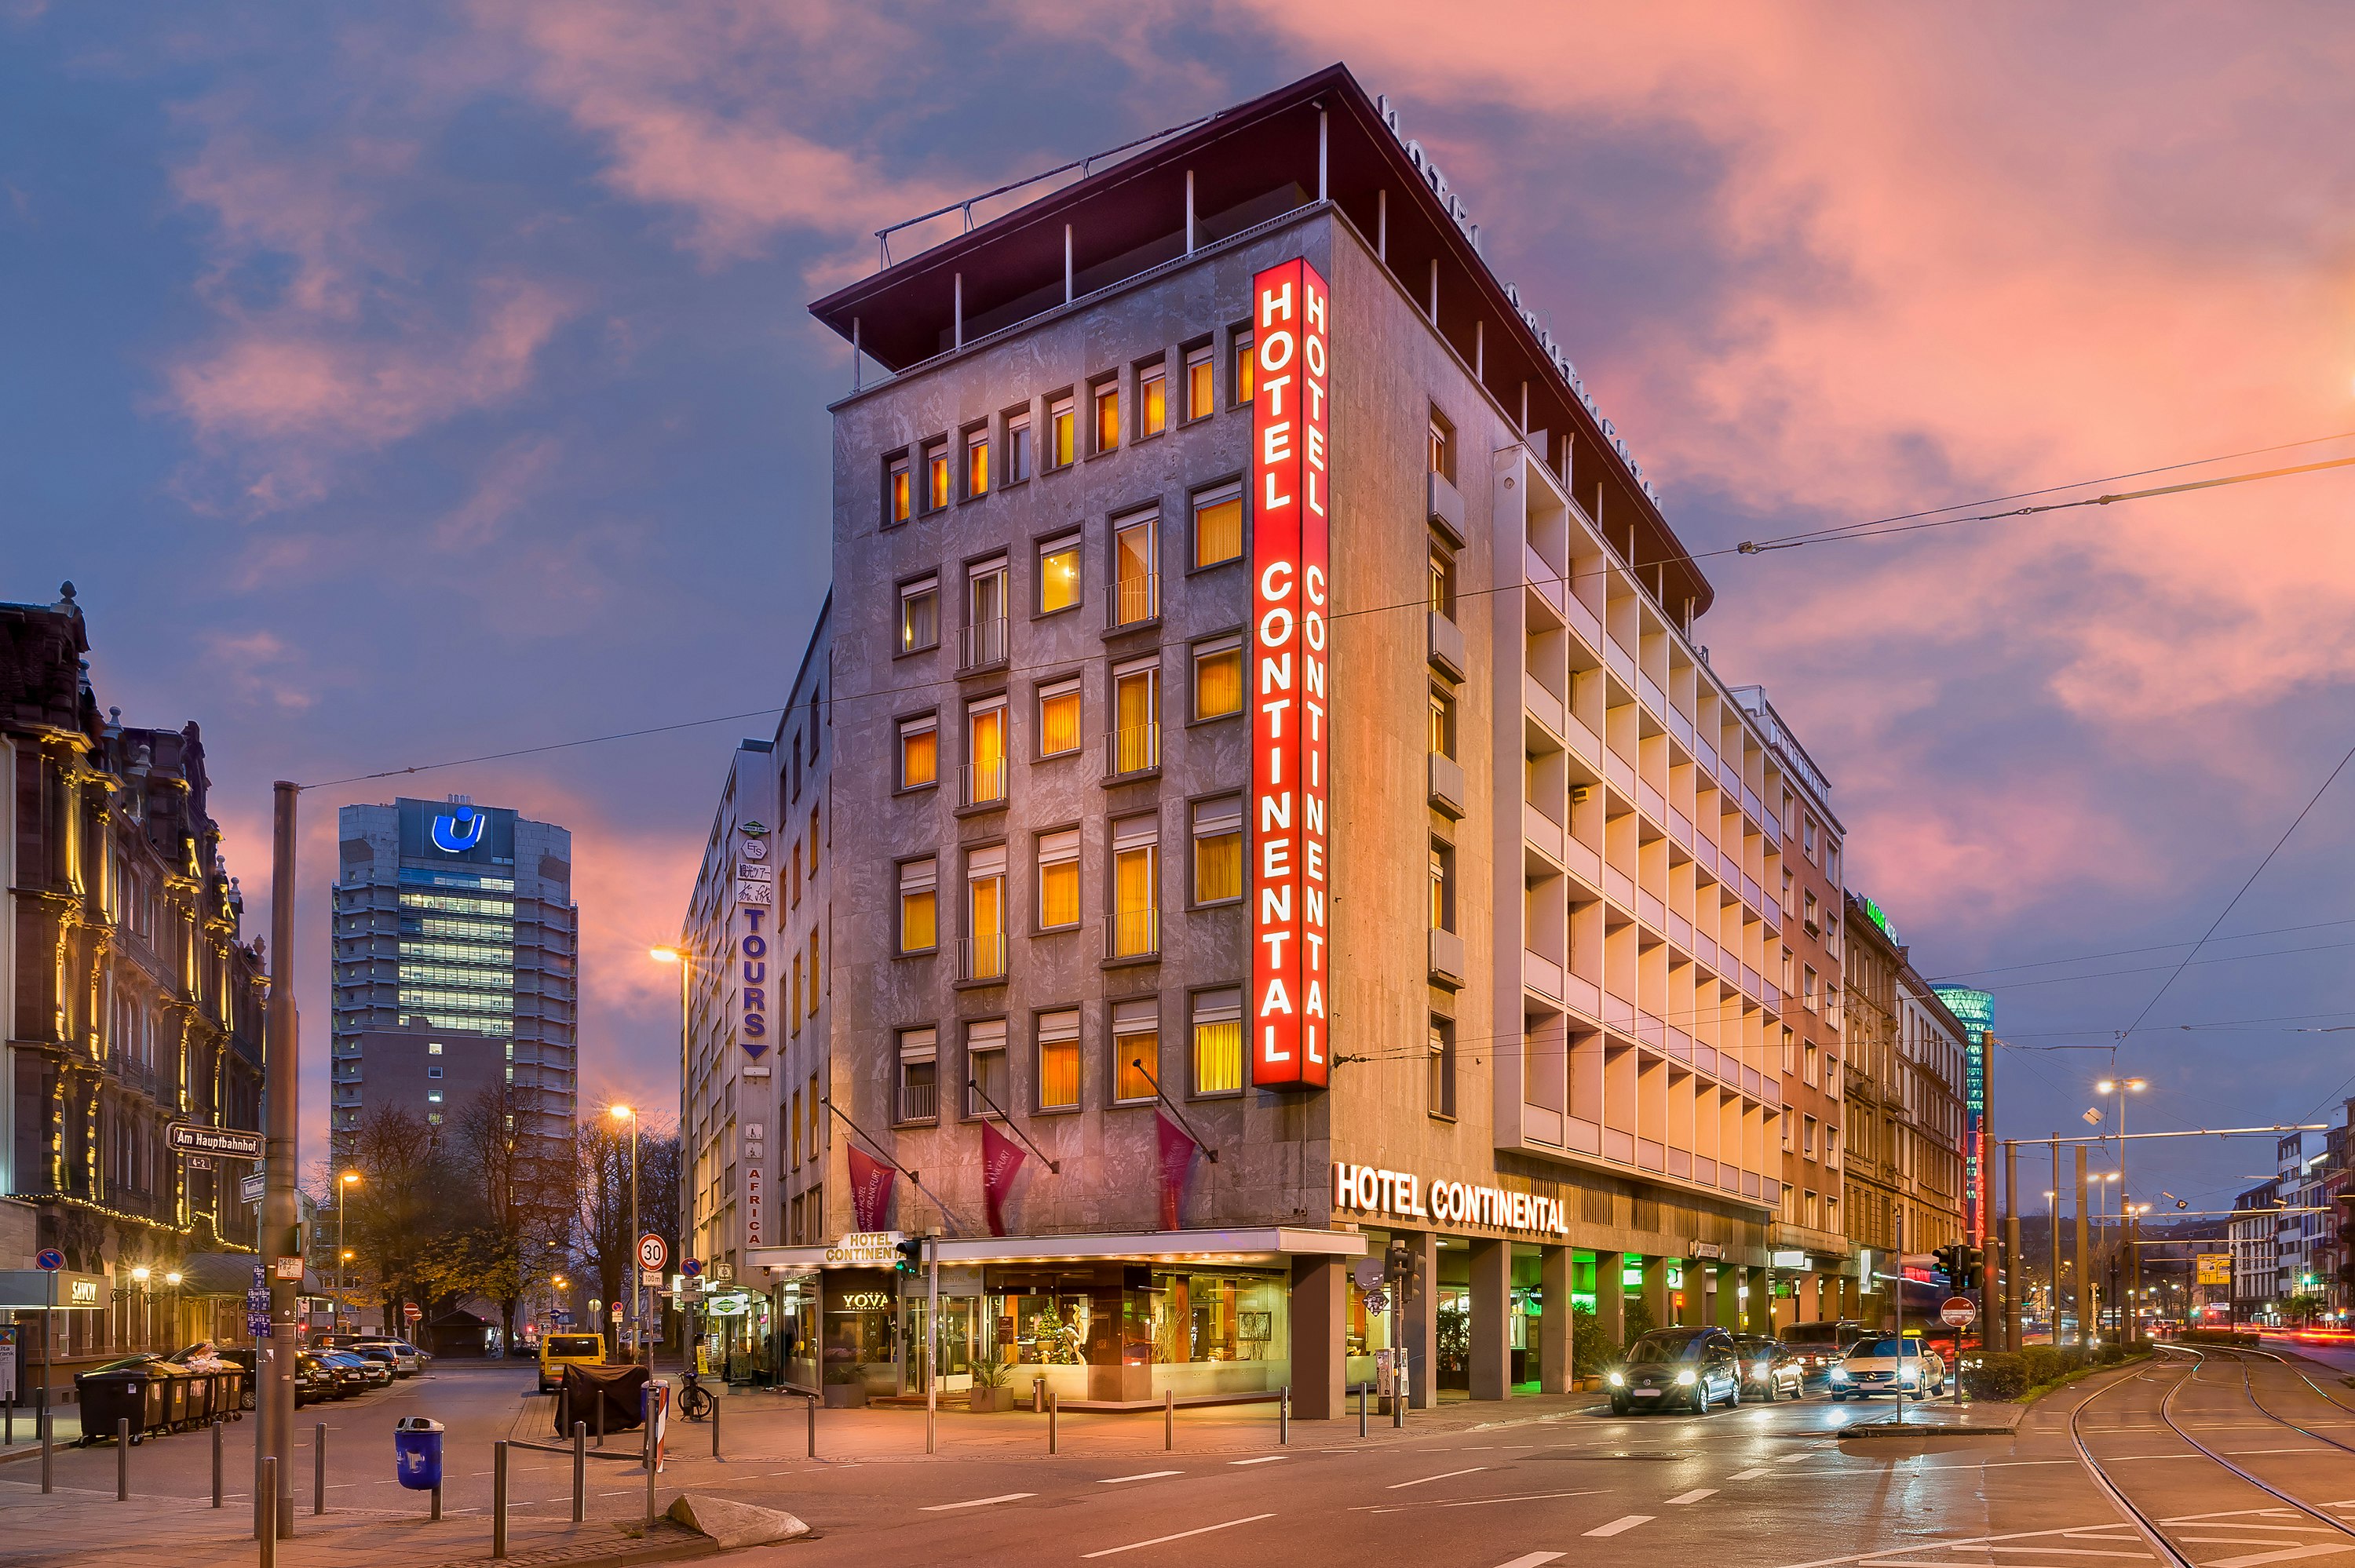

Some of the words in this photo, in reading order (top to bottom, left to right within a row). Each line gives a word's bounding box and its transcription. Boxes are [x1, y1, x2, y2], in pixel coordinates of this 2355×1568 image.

[1260, 282, 1294, 511] HOTEL
[1306, 283, 1326, 517] HOTEL
[1259, 560, 1294, 1063] CONTINENTAL
[1305, 564, 1325, 1064] CONTINENTAL
[747, 842, 762, 856] ETS
[742, 908, 767, 1037] TOURS
[177, 1131, 193, 1145] Am
[196, 1132, 257, 1152] Hauptbahnhof
[192, 1158, 206, 1168] 4-2
[748, 1169, 761, 1244] AFRICA
[1334, 1161, 1427, 1217] HOTEL
[1429, 1179, 1568, 1234] CONTINENTAL
[644, 1245, 661, 1260] 30
[826, 1246, 907, 1261] CONTINENTA
[850, 1233, 893, 1246] HOTEL
[71, 1281, 97, 1301] SAVOY
